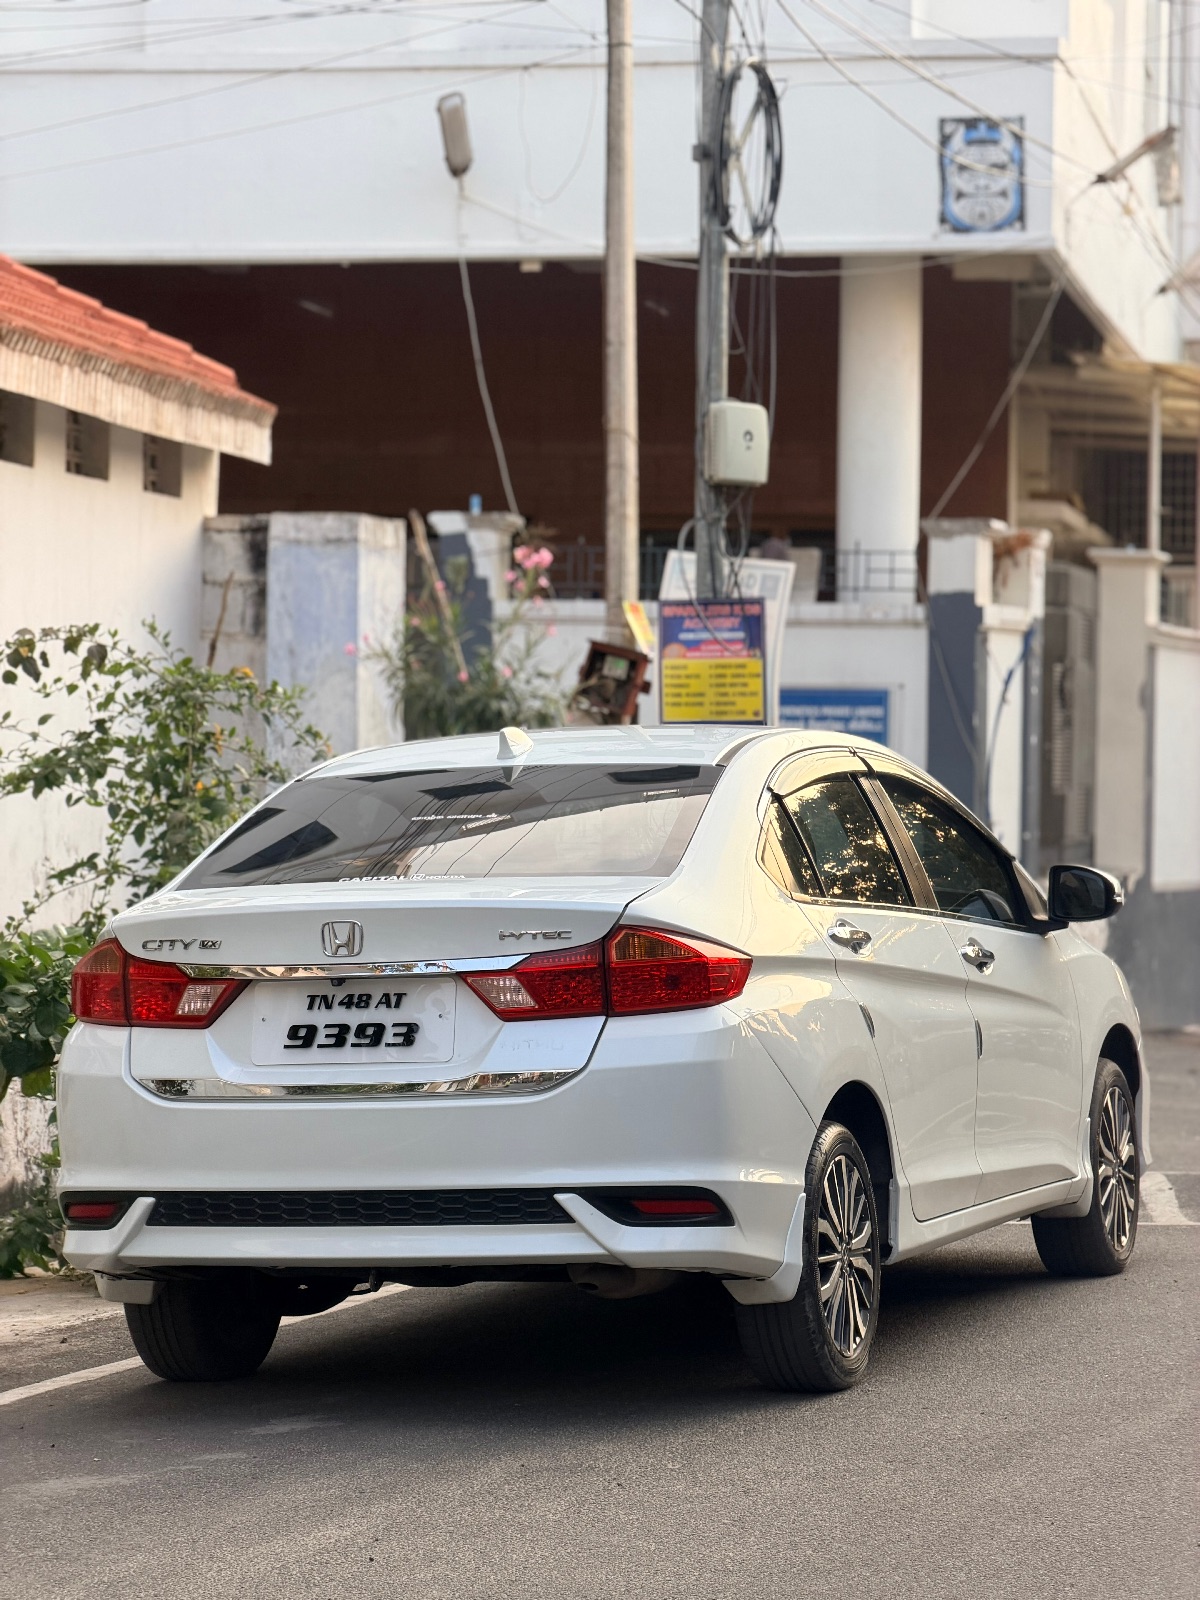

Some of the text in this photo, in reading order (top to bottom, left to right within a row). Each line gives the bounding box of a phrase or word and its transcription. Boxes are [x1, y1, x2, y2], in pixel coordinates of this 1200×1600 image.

[141, 938, 221, 951] CITY VX
[306, 992, 407, 1010] TN 48 AT
[283, 1022, 420, 1049] 9393
